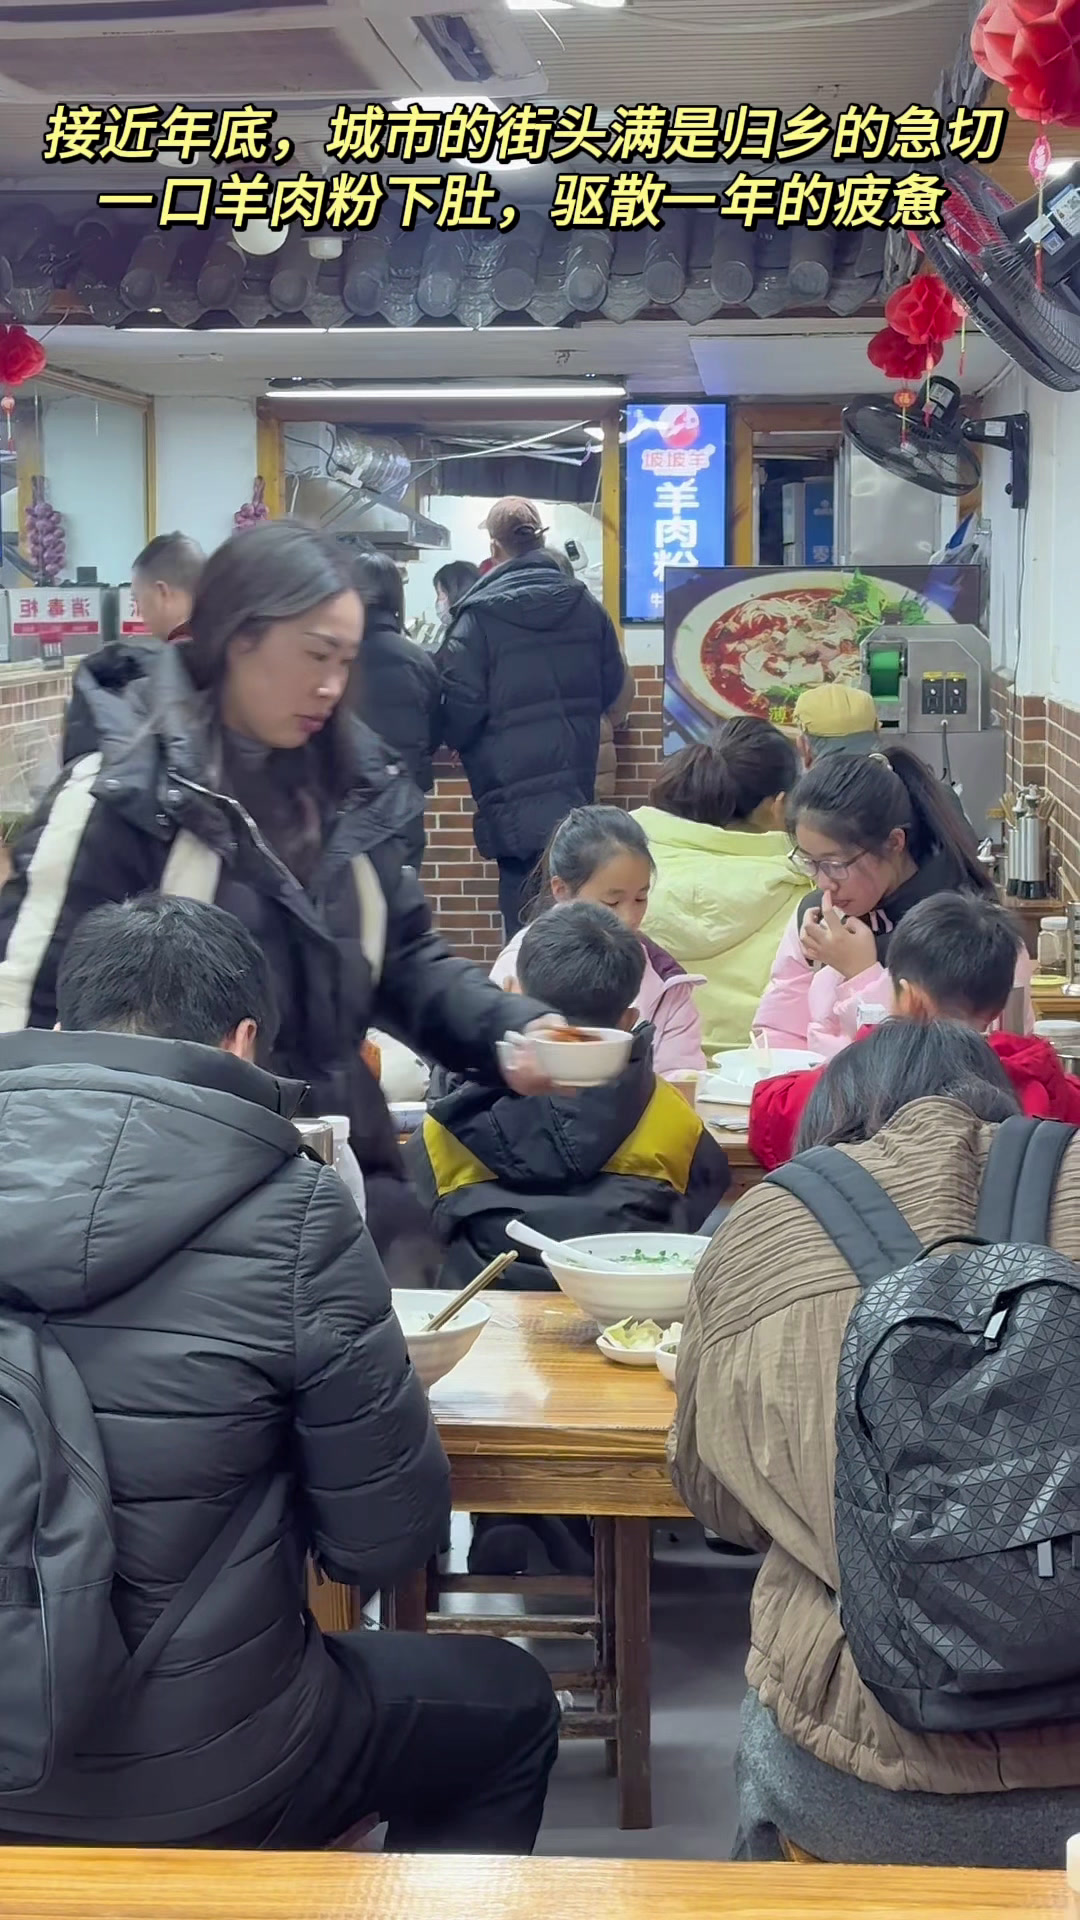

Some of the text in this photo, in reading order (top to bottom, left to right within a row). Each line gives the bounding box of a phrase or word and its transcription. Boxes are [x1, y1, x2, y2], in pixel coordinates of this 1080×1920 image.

[644, 450, 707, 469] 坡坡羊
[653, 478, 699, 582] 羊肉粉
